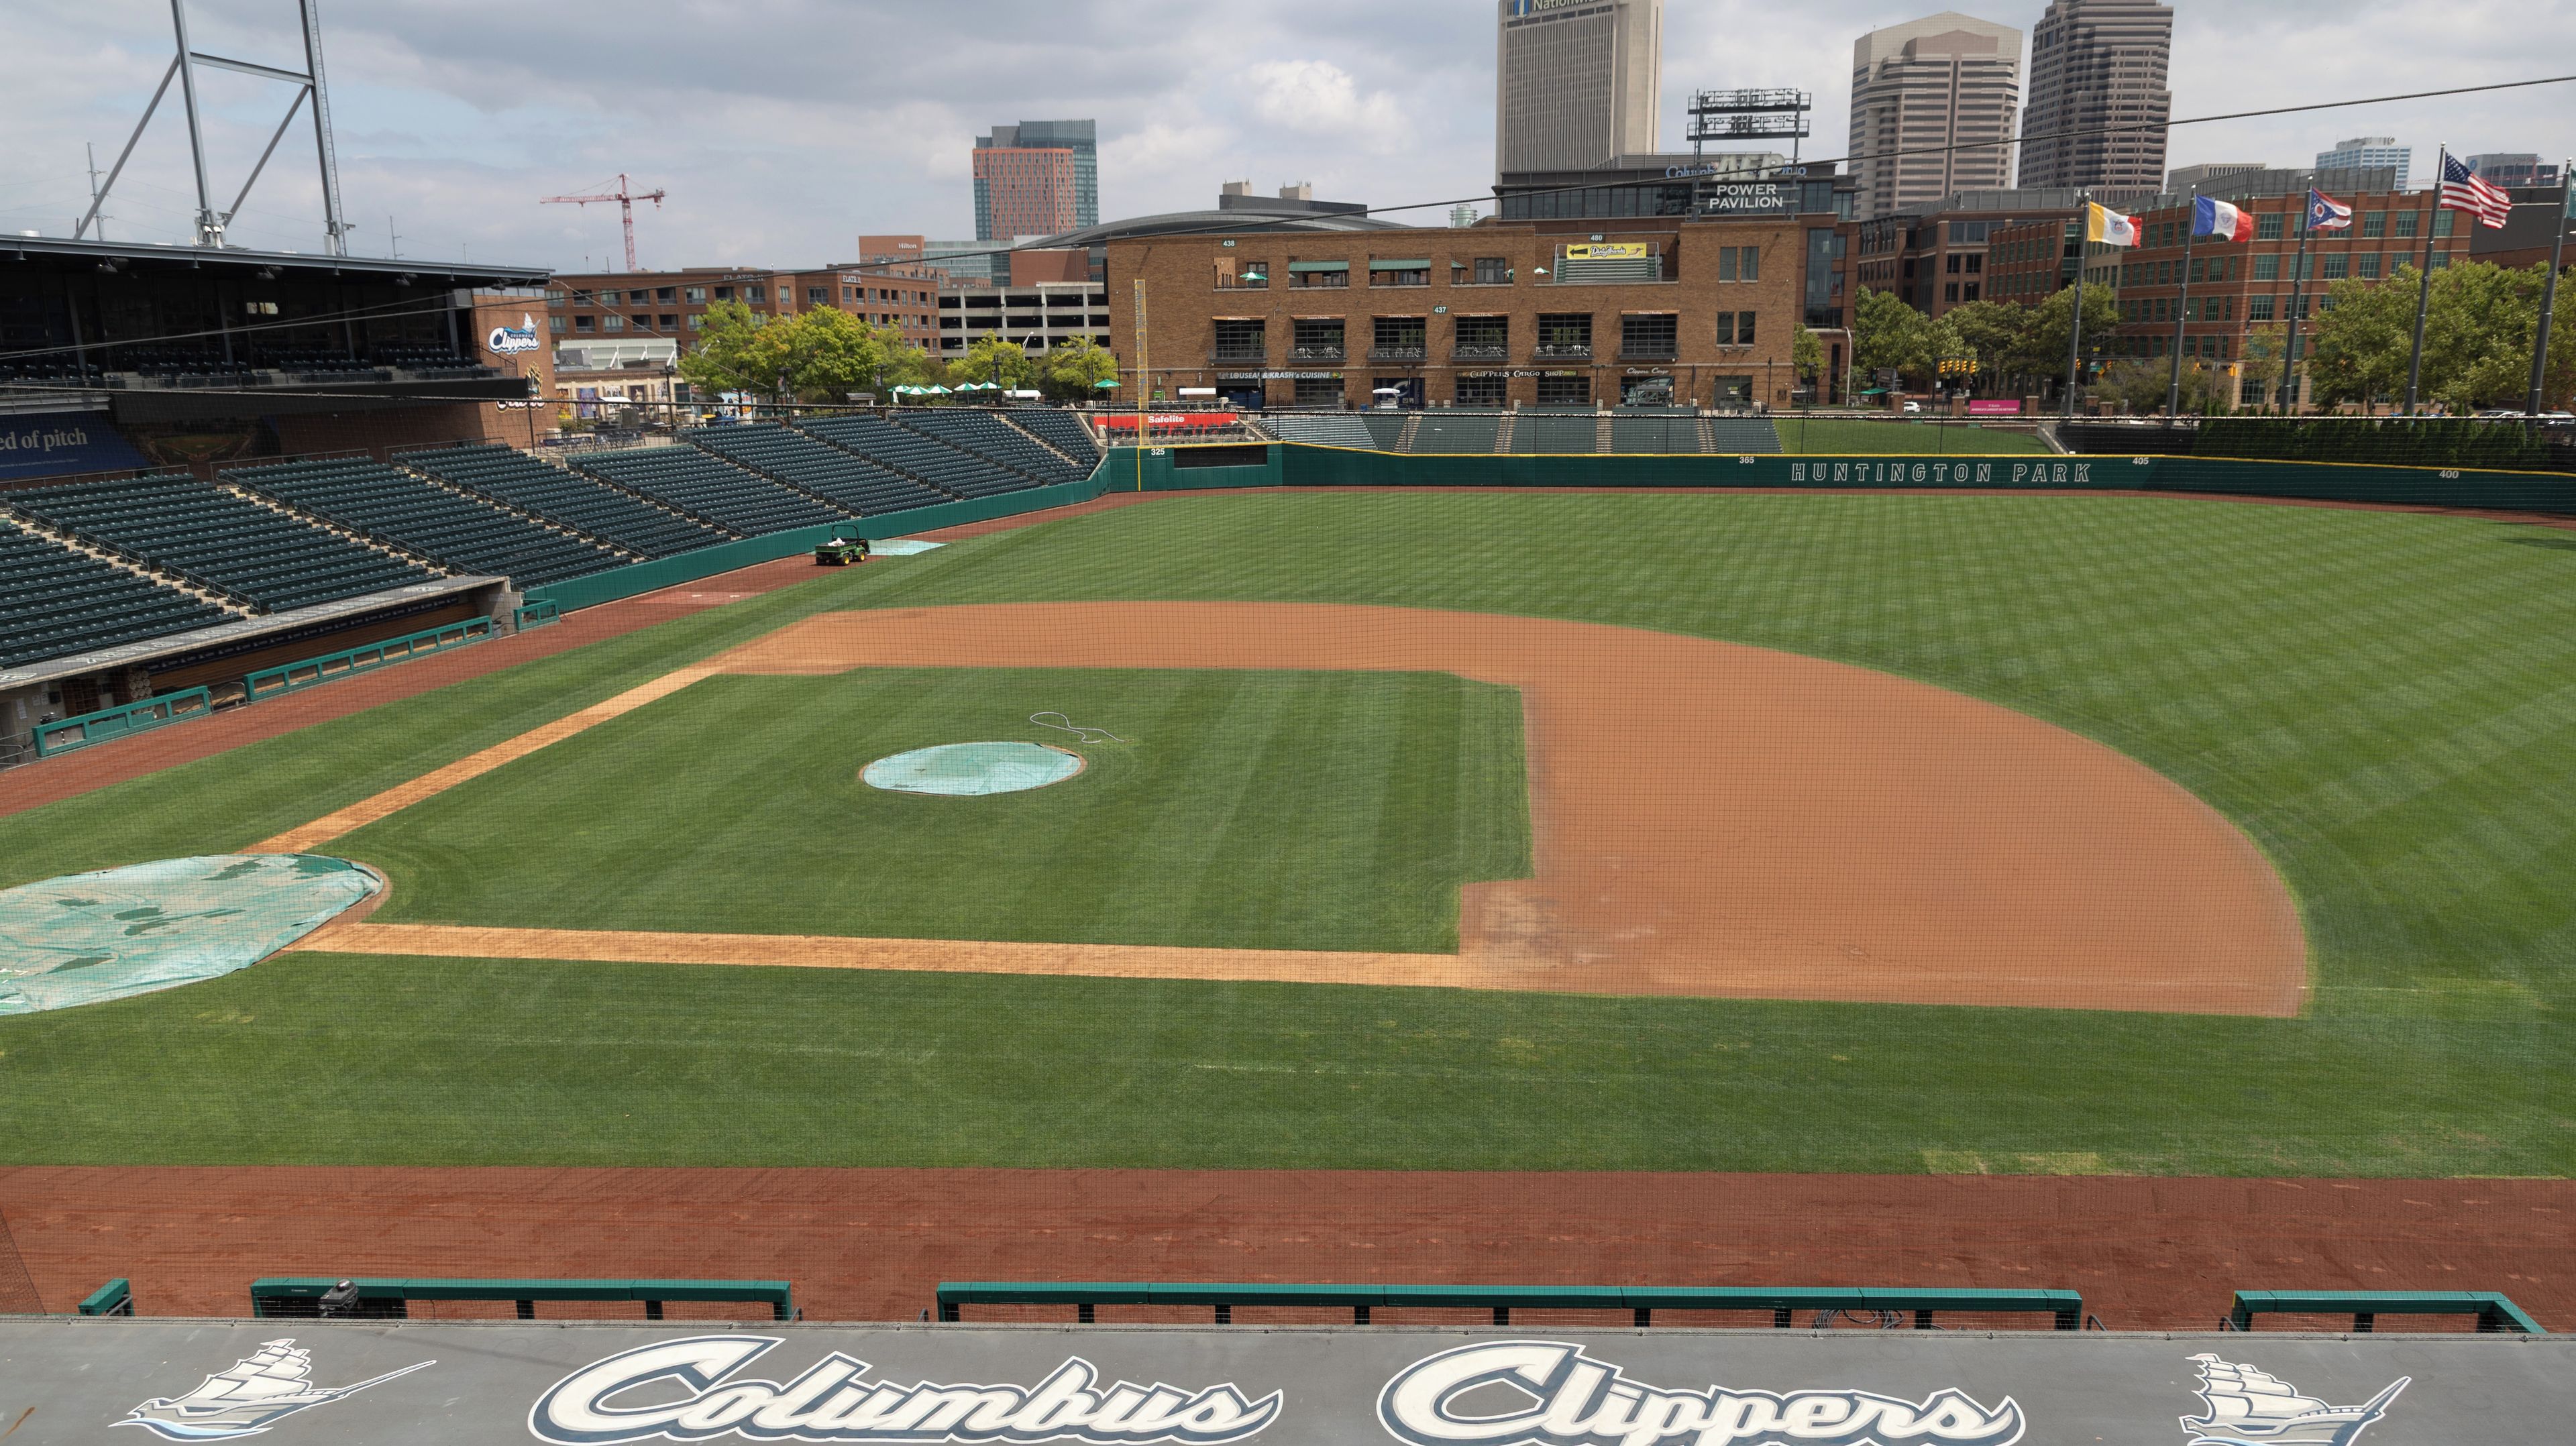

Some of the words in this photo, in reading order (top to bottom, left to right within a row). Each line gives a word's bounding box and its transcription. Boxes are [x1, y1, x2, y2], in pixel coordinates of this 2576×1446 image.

[1534, 0, 1596, 11] Nation
[1666, 164, 1715, 178] Columb
[1712, 154, 1785, 180] AEP
[1717, 184, 1777, 196] POWER
[1709, 197, 1783, 209] PAVILION
[489, 327, 540, 354] Clippers
[1148, 415, 1185, 423] Safelite
[21, 430, 40, 449] of
[43, 427, 88, 452] pitch
[1739, 456, 1755, 464] 365
[1791, 463, 1991, 482] HUNTINGTON
[2012, 463, 2090, 482] PARK
[2438, 469, 2459, 479] 400
[527, 1334, 1285, 1446] Columbus
[1376, 1339, 2027, 1446] Clippers
